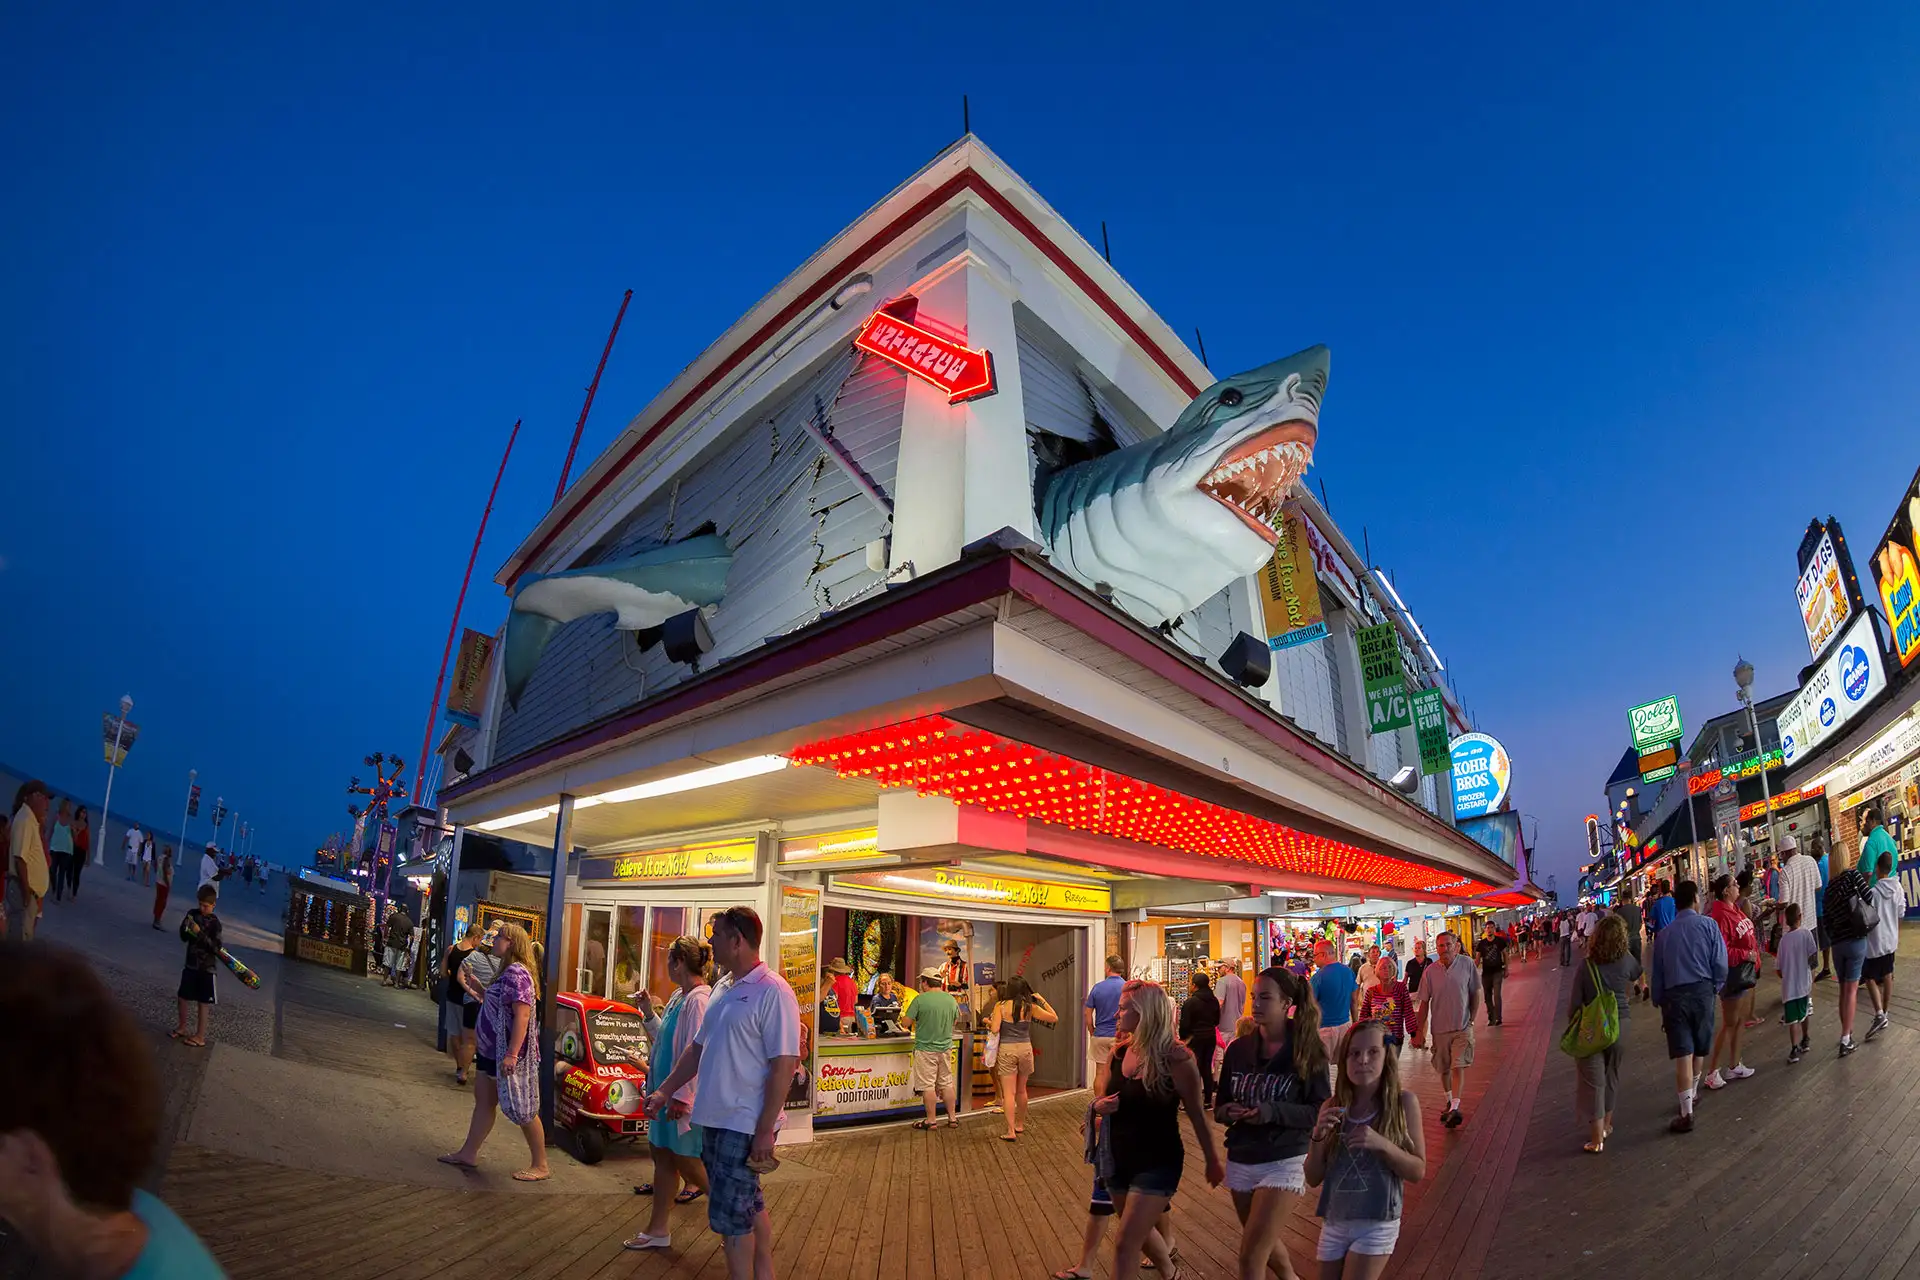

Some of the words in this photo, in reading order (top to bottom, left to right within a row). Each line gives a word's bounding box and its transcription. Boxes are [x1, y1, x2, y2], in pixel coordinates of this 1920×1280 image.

[1797, 572, 1813, 606] HOT
[1811, 538, 1833, 581] DOGS
[1282, 576, 1295, 593] or
[1285, 594, 1306, 627] Not!
[1359, 628, 1383, 643] TAKE
[1385, 624, 1392, 635] A
[1360, 638, 1395, 656] BREAK
[1362, 654, 1383, 666] FROM
[1384, 650, 1397, 661] THE
[1365, 660, 1400, 681] SUN.
[1368, 689, 1381, 701] WE
[1382, 683, 1403, 698] HAVE
[1812, 668, 1830, 699] DOGS
[1413, 697, 1424, 706] WE
[1424, 692, 1440, 703] ONLY
[1372, 695, 1407, 725] A/C
[1416, 701, 1440, 717] HAVE
[1635, 701, 1675, 731] Dolle's
[1417, 713, 1442, 731] FUN
[1422, 747, 1438, 760] END
[1452, 757, 1489, 777] KOHR
[1647, 767, 1671, 779] POPCORN
[1721, 762, 1743, 777] SALT
[1741, 757, 1782, 778] POPCORN
[1456, 799, 1488, 811] CUSTARD
[1458, 791, 1486, 803] FROZEN
[1783, 794, 1801, 806] CORN
[613, 858, 643, 878] Believe
[643, 855, 654, 876] It
[653, 860, 666, 876] or
[665, 851, 691, 876] Not!
[1005, 889, 1021, 903] or
[1020, 883, 1050, 906] Not!
[1041, 953, 1075, 982] FRAGILE
[582, 1083, 592, 1093] It
[816, 1076, 856, 1092] Believe
[857, 1073, 871, 1089] It
[871, 1075, 884, 1089] or
[885, 1069, 912, 1088] Not!
[836, 1088, 890, 1104] ODDITORIUM
